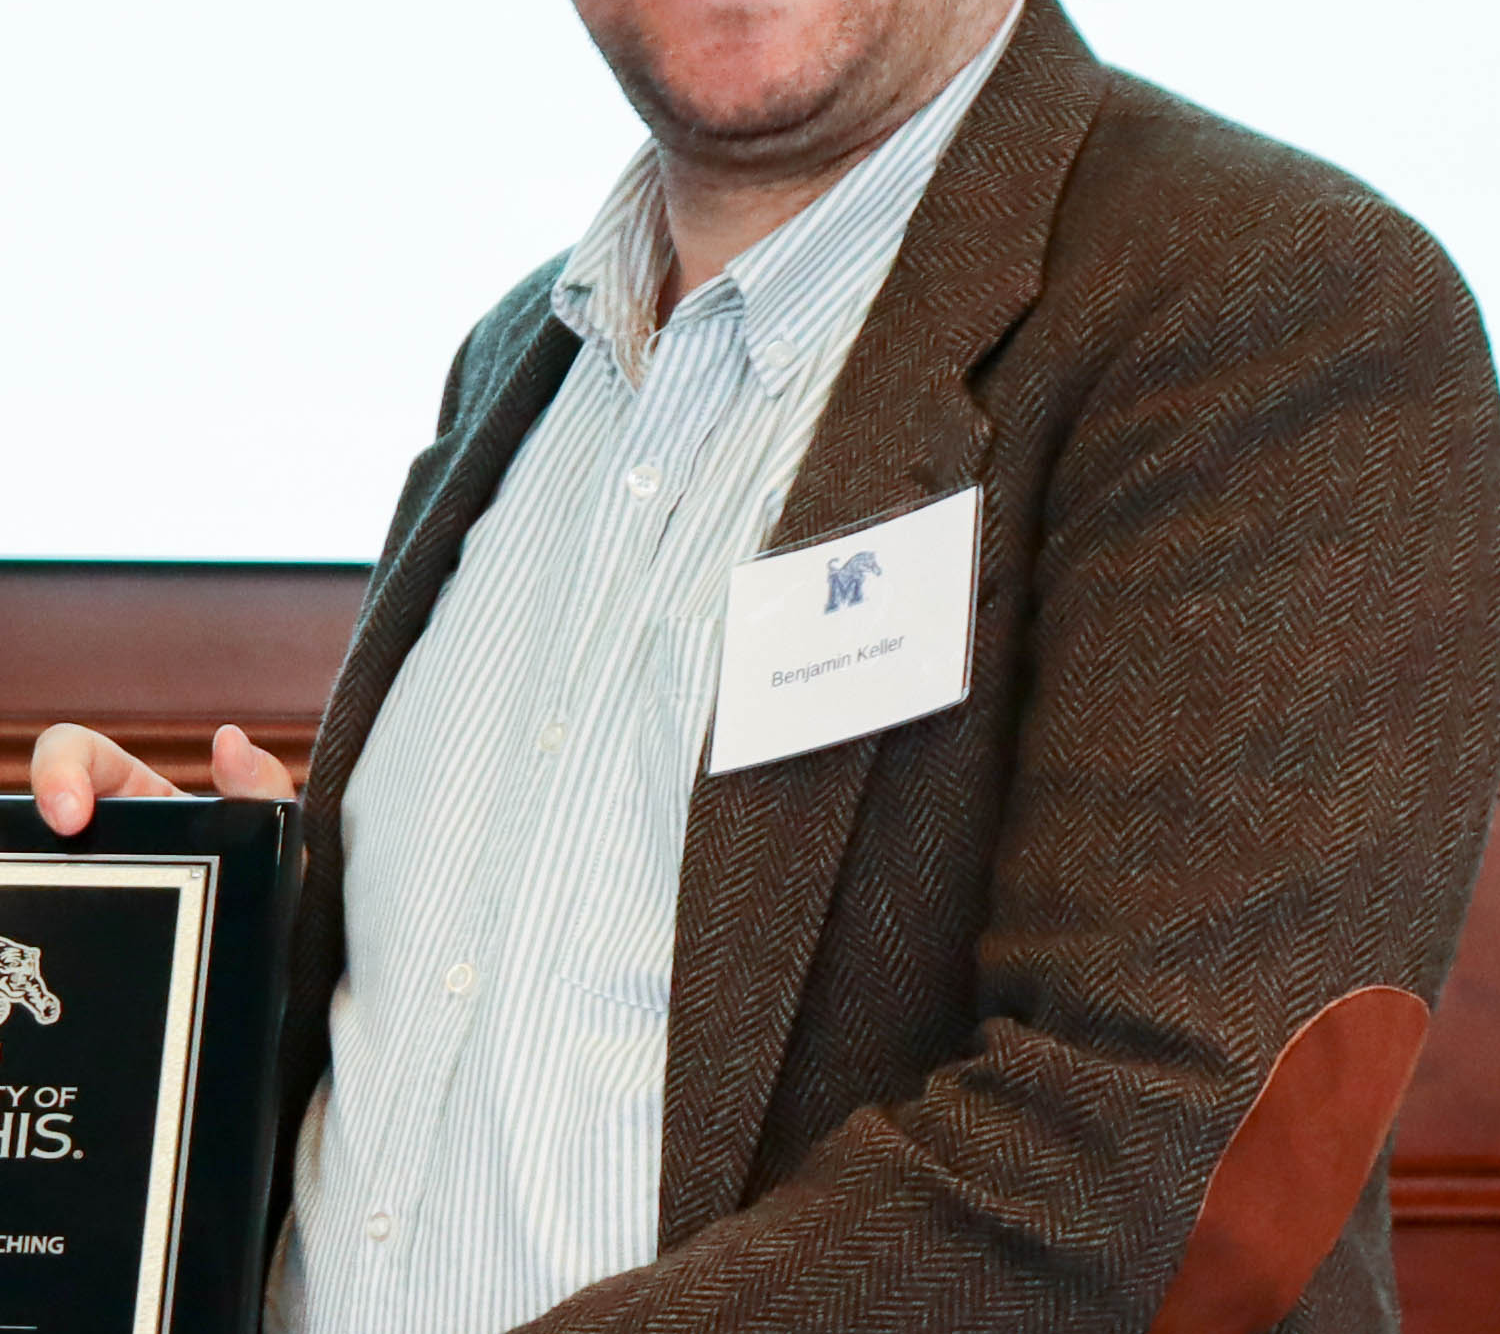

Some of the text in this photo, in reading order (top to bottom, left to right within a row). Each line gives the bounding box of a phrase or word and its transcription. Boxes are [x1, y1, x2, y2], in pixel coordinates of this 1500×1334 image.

[770, 635, 905, 689] Benjamin Keller
[34, 1085, 79, 1108] OF
